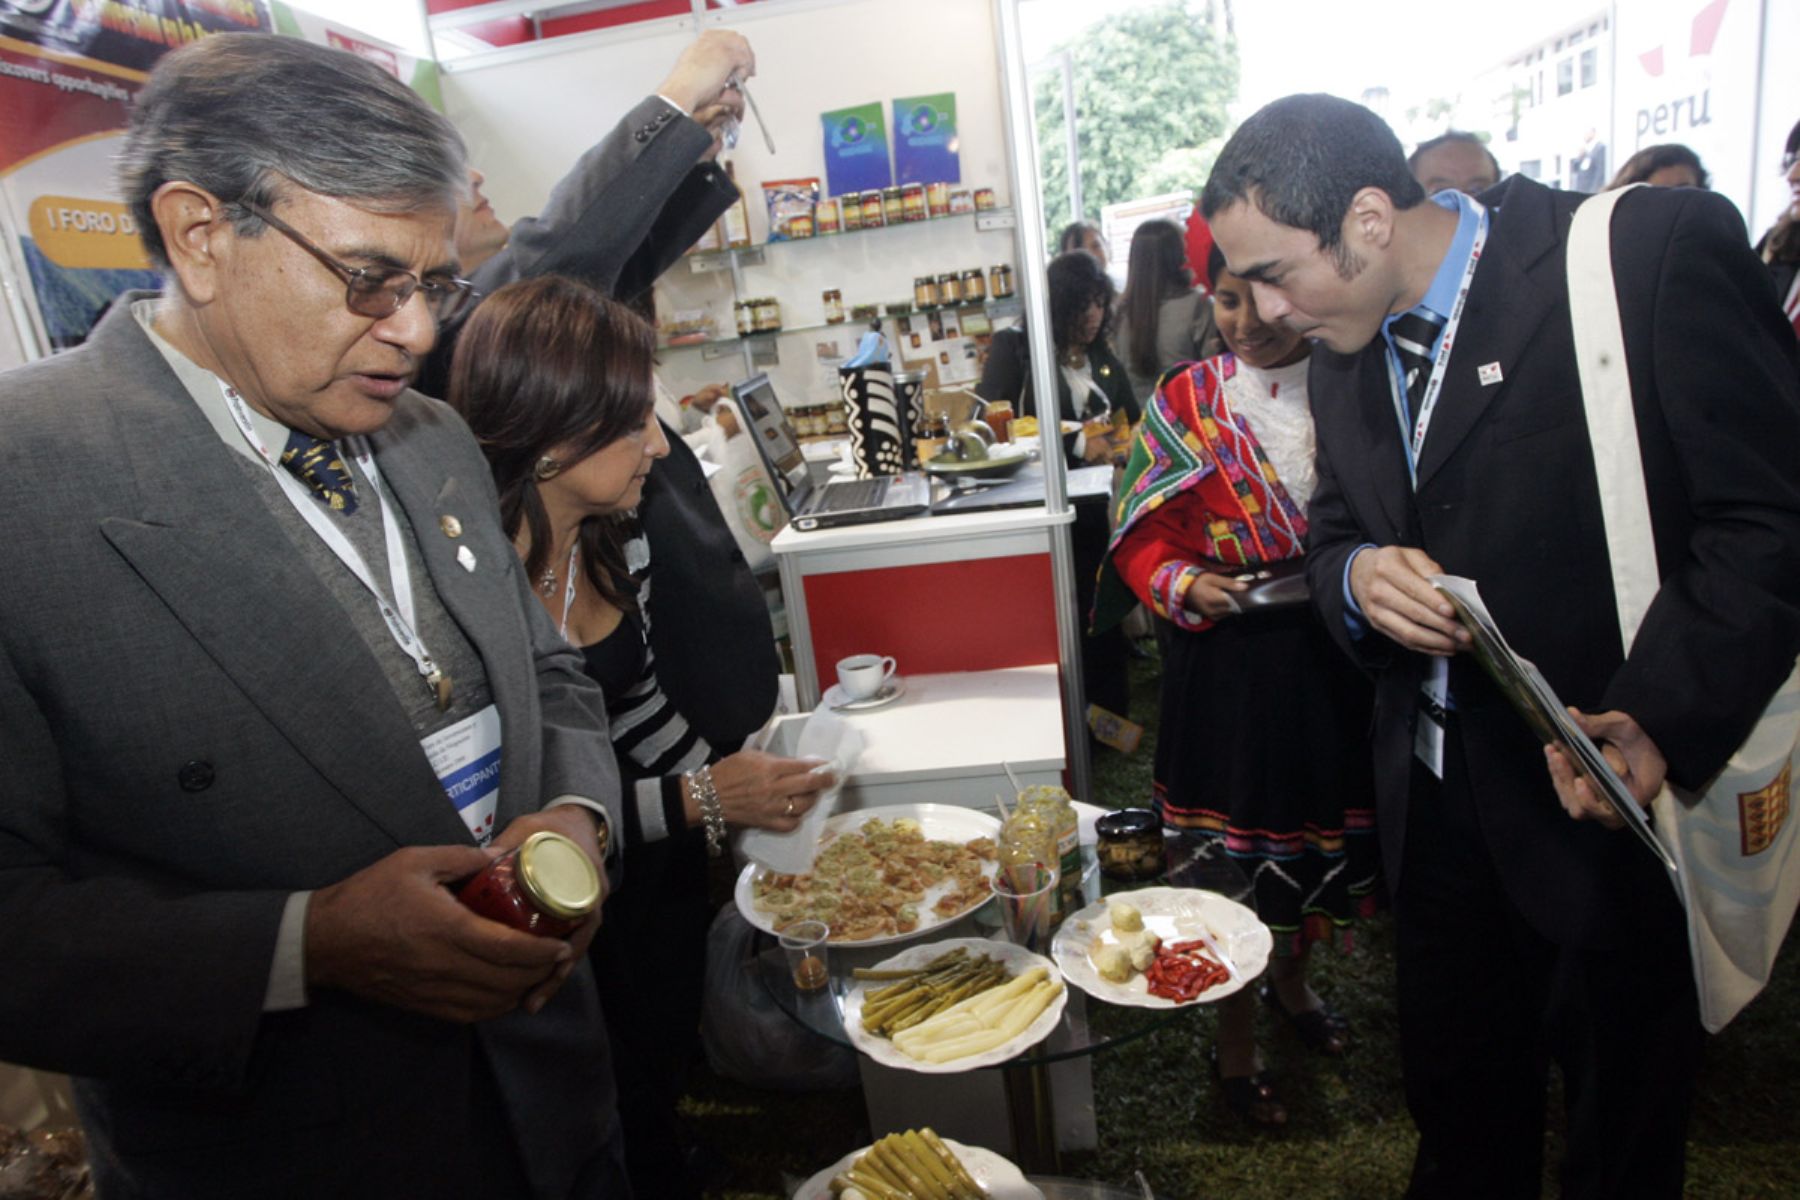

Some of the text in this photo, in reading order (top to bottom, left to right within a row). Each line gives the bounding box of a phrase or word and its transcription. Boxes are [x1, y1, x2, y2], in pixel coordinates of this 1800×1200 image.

[0, 58, 50, 84] iscovers
[47, 207, 137, 236] I FORO D
[445, 759, 502, 799] RTICIPANT
